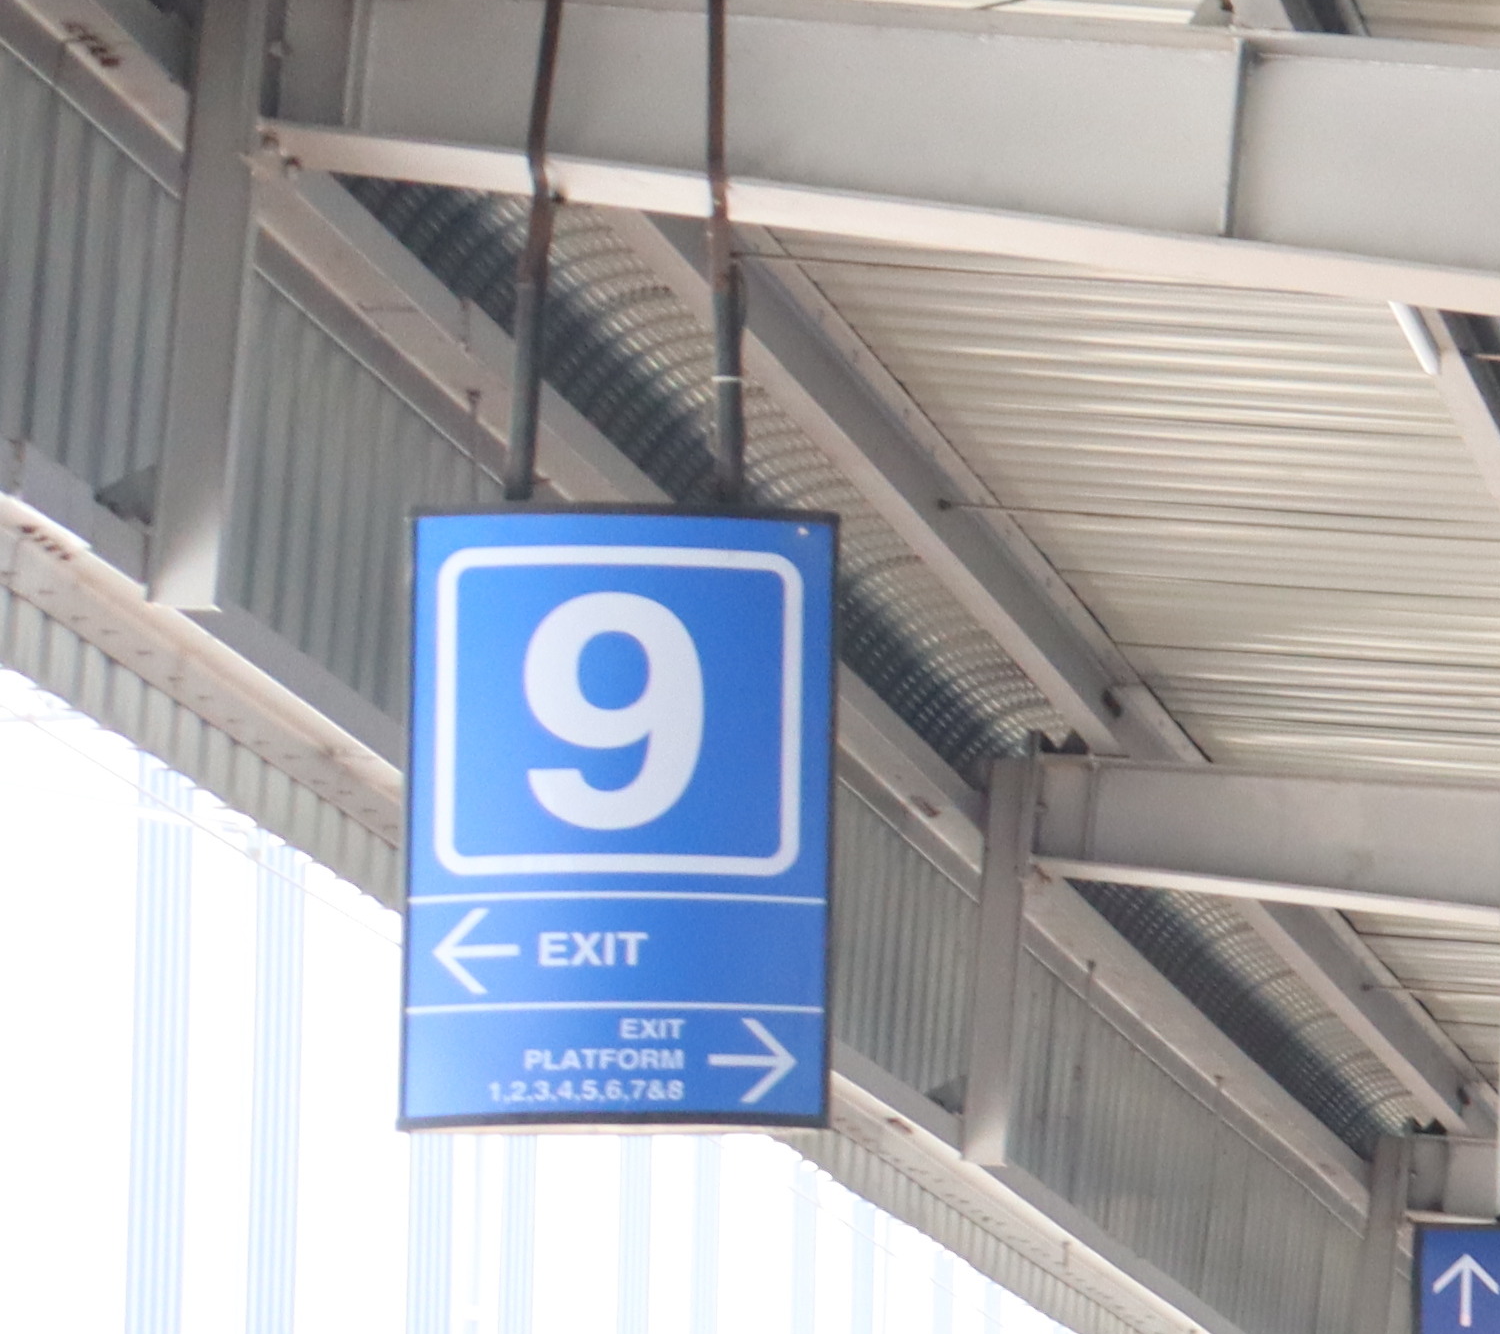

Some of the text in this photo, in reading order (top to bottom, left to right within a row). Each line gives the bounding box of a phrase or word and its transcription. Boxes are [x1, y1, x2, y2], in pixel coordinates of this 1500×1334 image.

[522, 592, 703, 830] 9
[537, 931, 647, 968] EXIT
[620, 1018, 684, 1039] EXIT
[522, 1049, 682, 1071] PLATFORM
